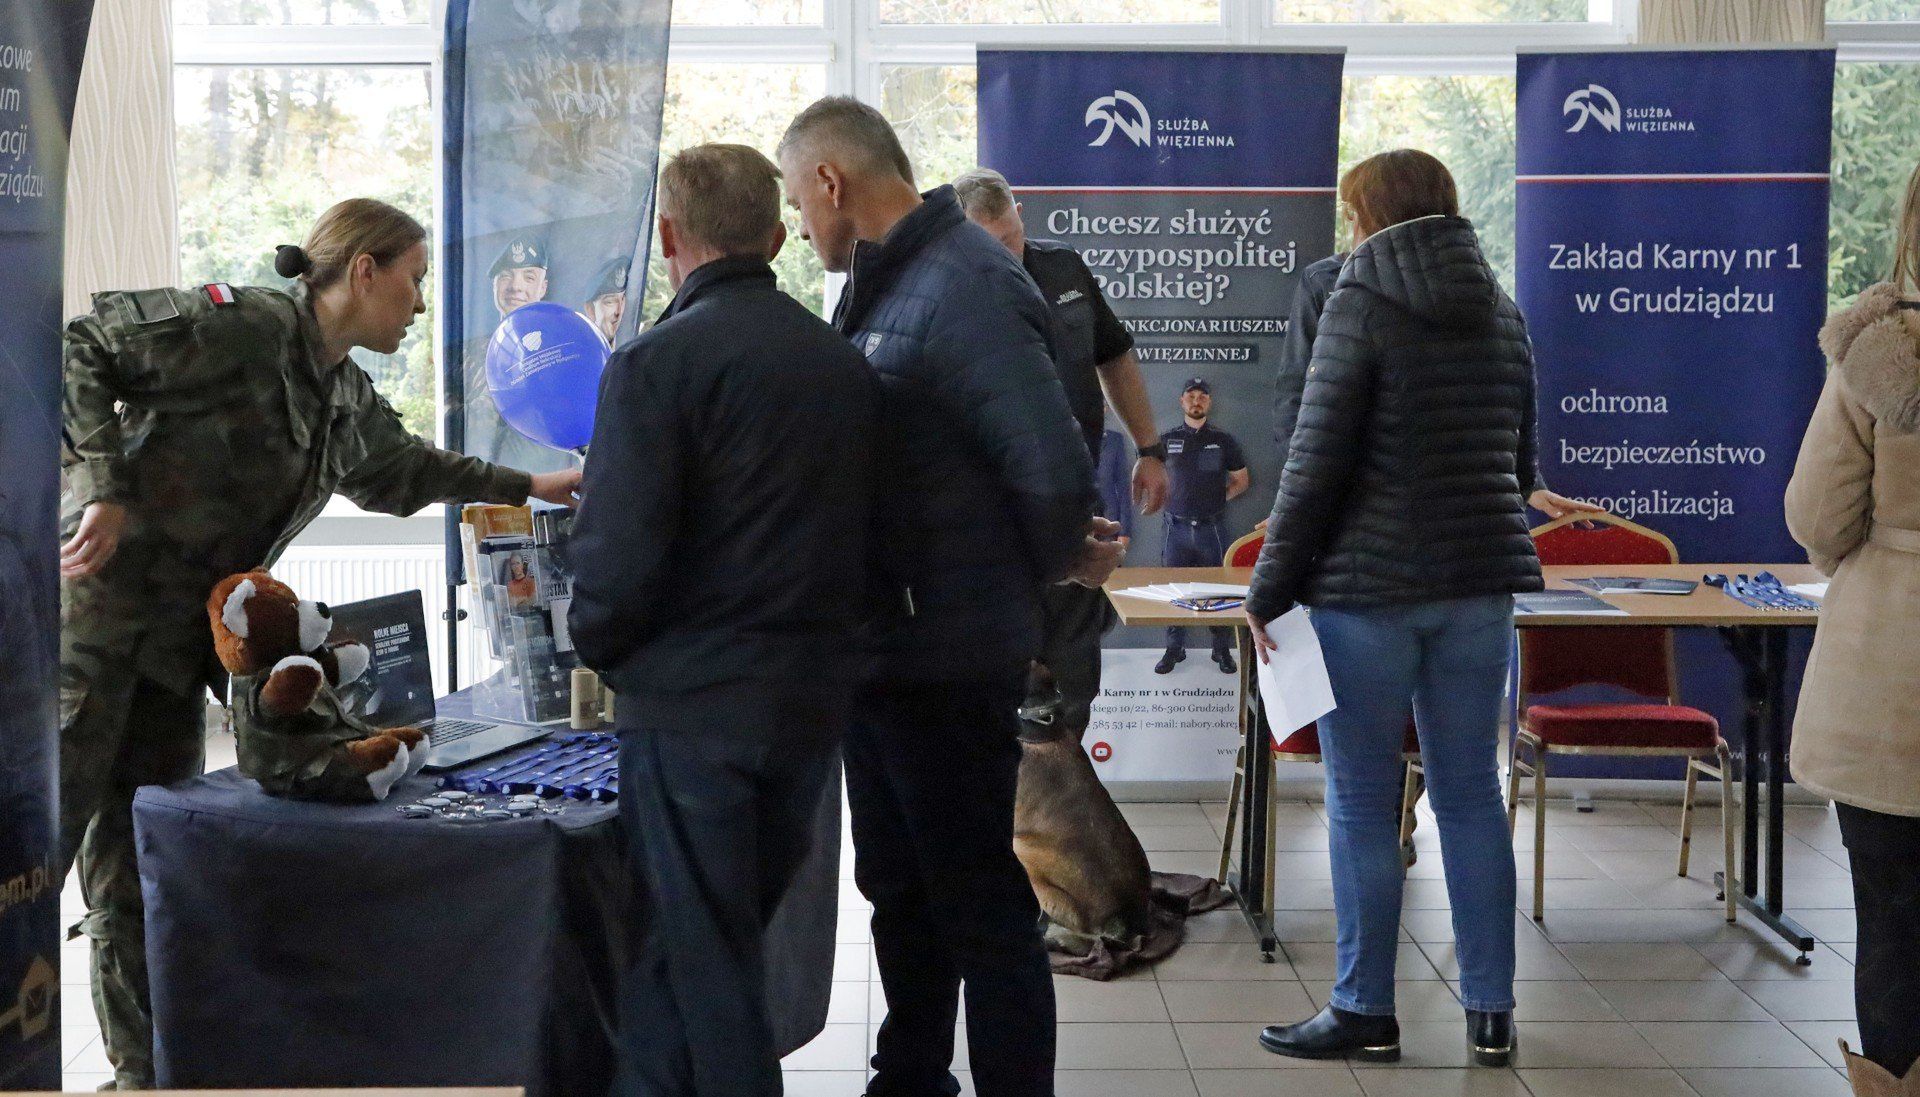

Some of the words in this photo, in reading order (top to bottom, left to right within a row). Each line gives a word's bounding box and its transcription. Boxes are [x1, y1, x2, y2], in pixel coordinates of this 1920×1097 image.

[1626, 106, 1673, 119] SŁUŻBA
[1157, 117, 1209, 131] SŁUŻBA
[1626, 121, 1696, 133] WIĘZIENNA
[1157, 135, 1235, 149] WIĘZIENNA
[1047, 208, 1160, 235] Chcesz
[1169, 208, 1272, 240] służyć
[1076, 240, 1297, 274] czypospolitej
[1549, 242, 1643, 269] Zakład
[1653, 243, 1736, 275] Karny
[1745, 249, 1777, 269] nr
[1786, 243, 1802, 269] 1
[1575, 293, 1600, 313] w
[1609, 285, 1774, 319] Grudziądzu
[1120, 319, 1290, 333] NKCJONARIUSZEM
[1136, 347, 1251, 363] WIĘZIENNEJ
[1561, 388, 1668, 413] ochrona
[1560, 439, 1765, 470] bezpieczeństwo
[1567, 489, 1734, 521] ocjalizacja
[1104, 689, 1135, 699] Karny
[1173, 688, 1235, 699] Grudziądzu
[1188, 704, 1235, 714] Grudziądz
